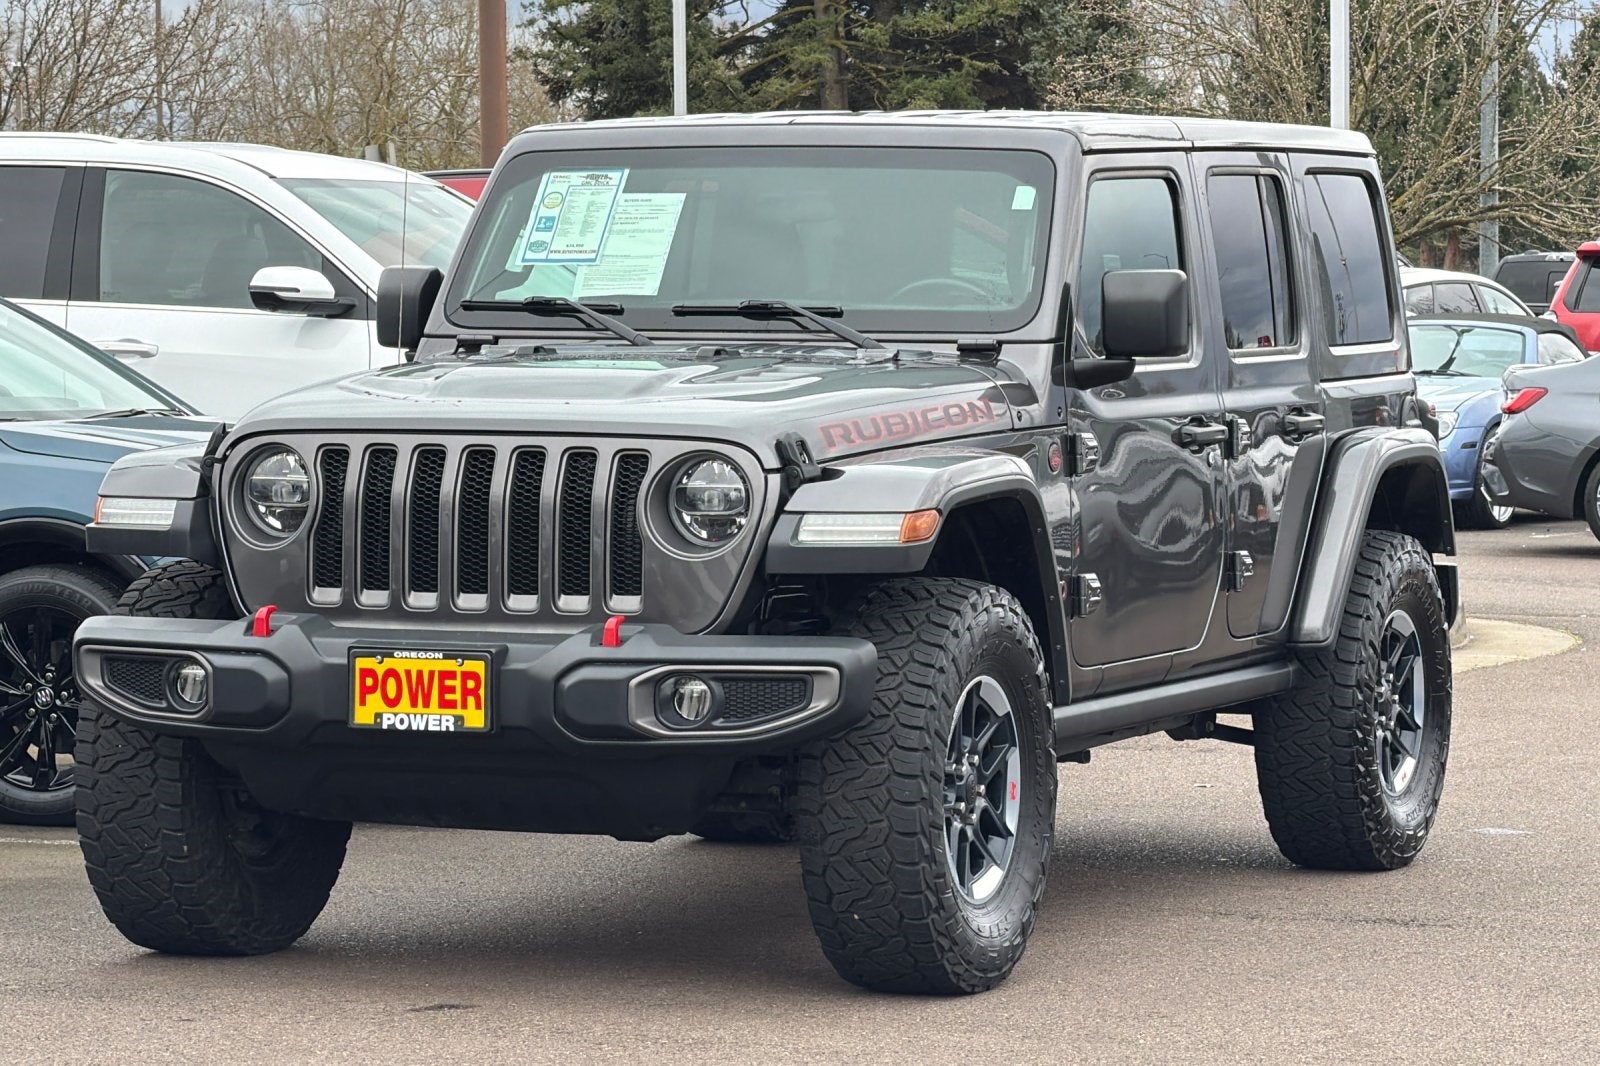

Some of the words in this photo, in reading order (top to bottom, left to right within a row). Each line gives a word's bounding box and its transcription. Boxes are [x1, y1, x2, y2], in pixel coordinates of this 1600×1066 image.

[819, 398, 995, 450] RUBICON
[393, 651, 444, 659] OREGON
[358, 667, 482, 710] POWER
[382, 713, 455, 731] POWER
